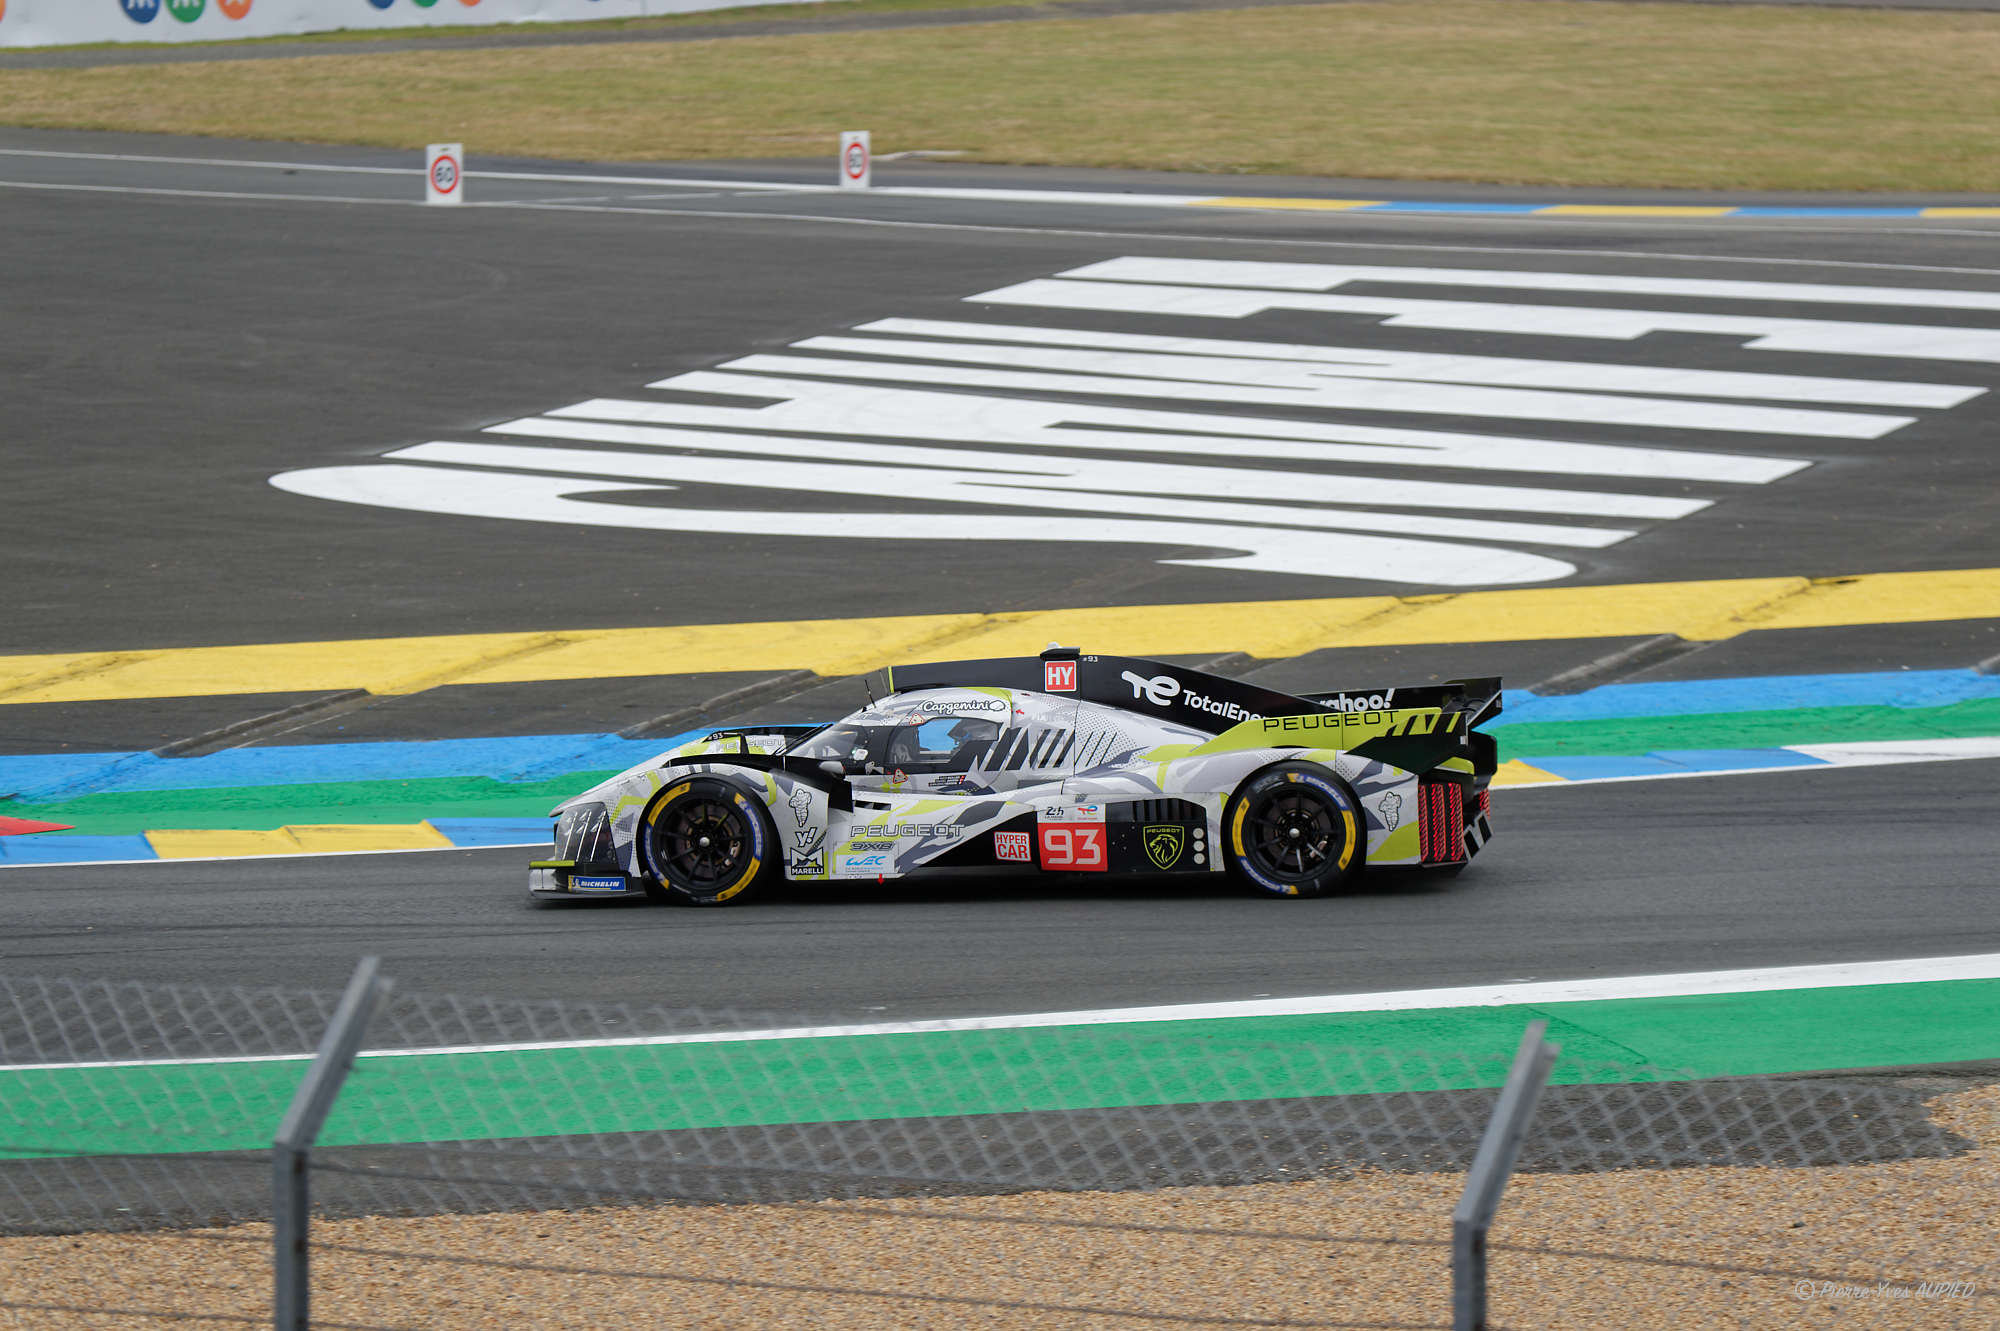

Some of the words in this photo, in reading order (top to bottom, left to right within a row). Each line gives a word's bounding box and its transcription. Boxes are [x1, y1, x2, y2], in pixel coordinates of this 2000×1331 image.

[1047, 666, 1072, 686] HY
[922, 700, 989, 715] Capgemini
[1319, 688, 1396, 713] ahoo!
[1263, 711, 1399, 732] PEUGEOT
[850, 823, 966, 838] PEUGEOT
[996, 833, 1027, 844] HYPER
[997, 844, 1028, 859] CAR
[1044, 829, 1100, 864] 93
[845, 855, 887, 866] WEC
[791, 867, 824, 875] MARELLI
